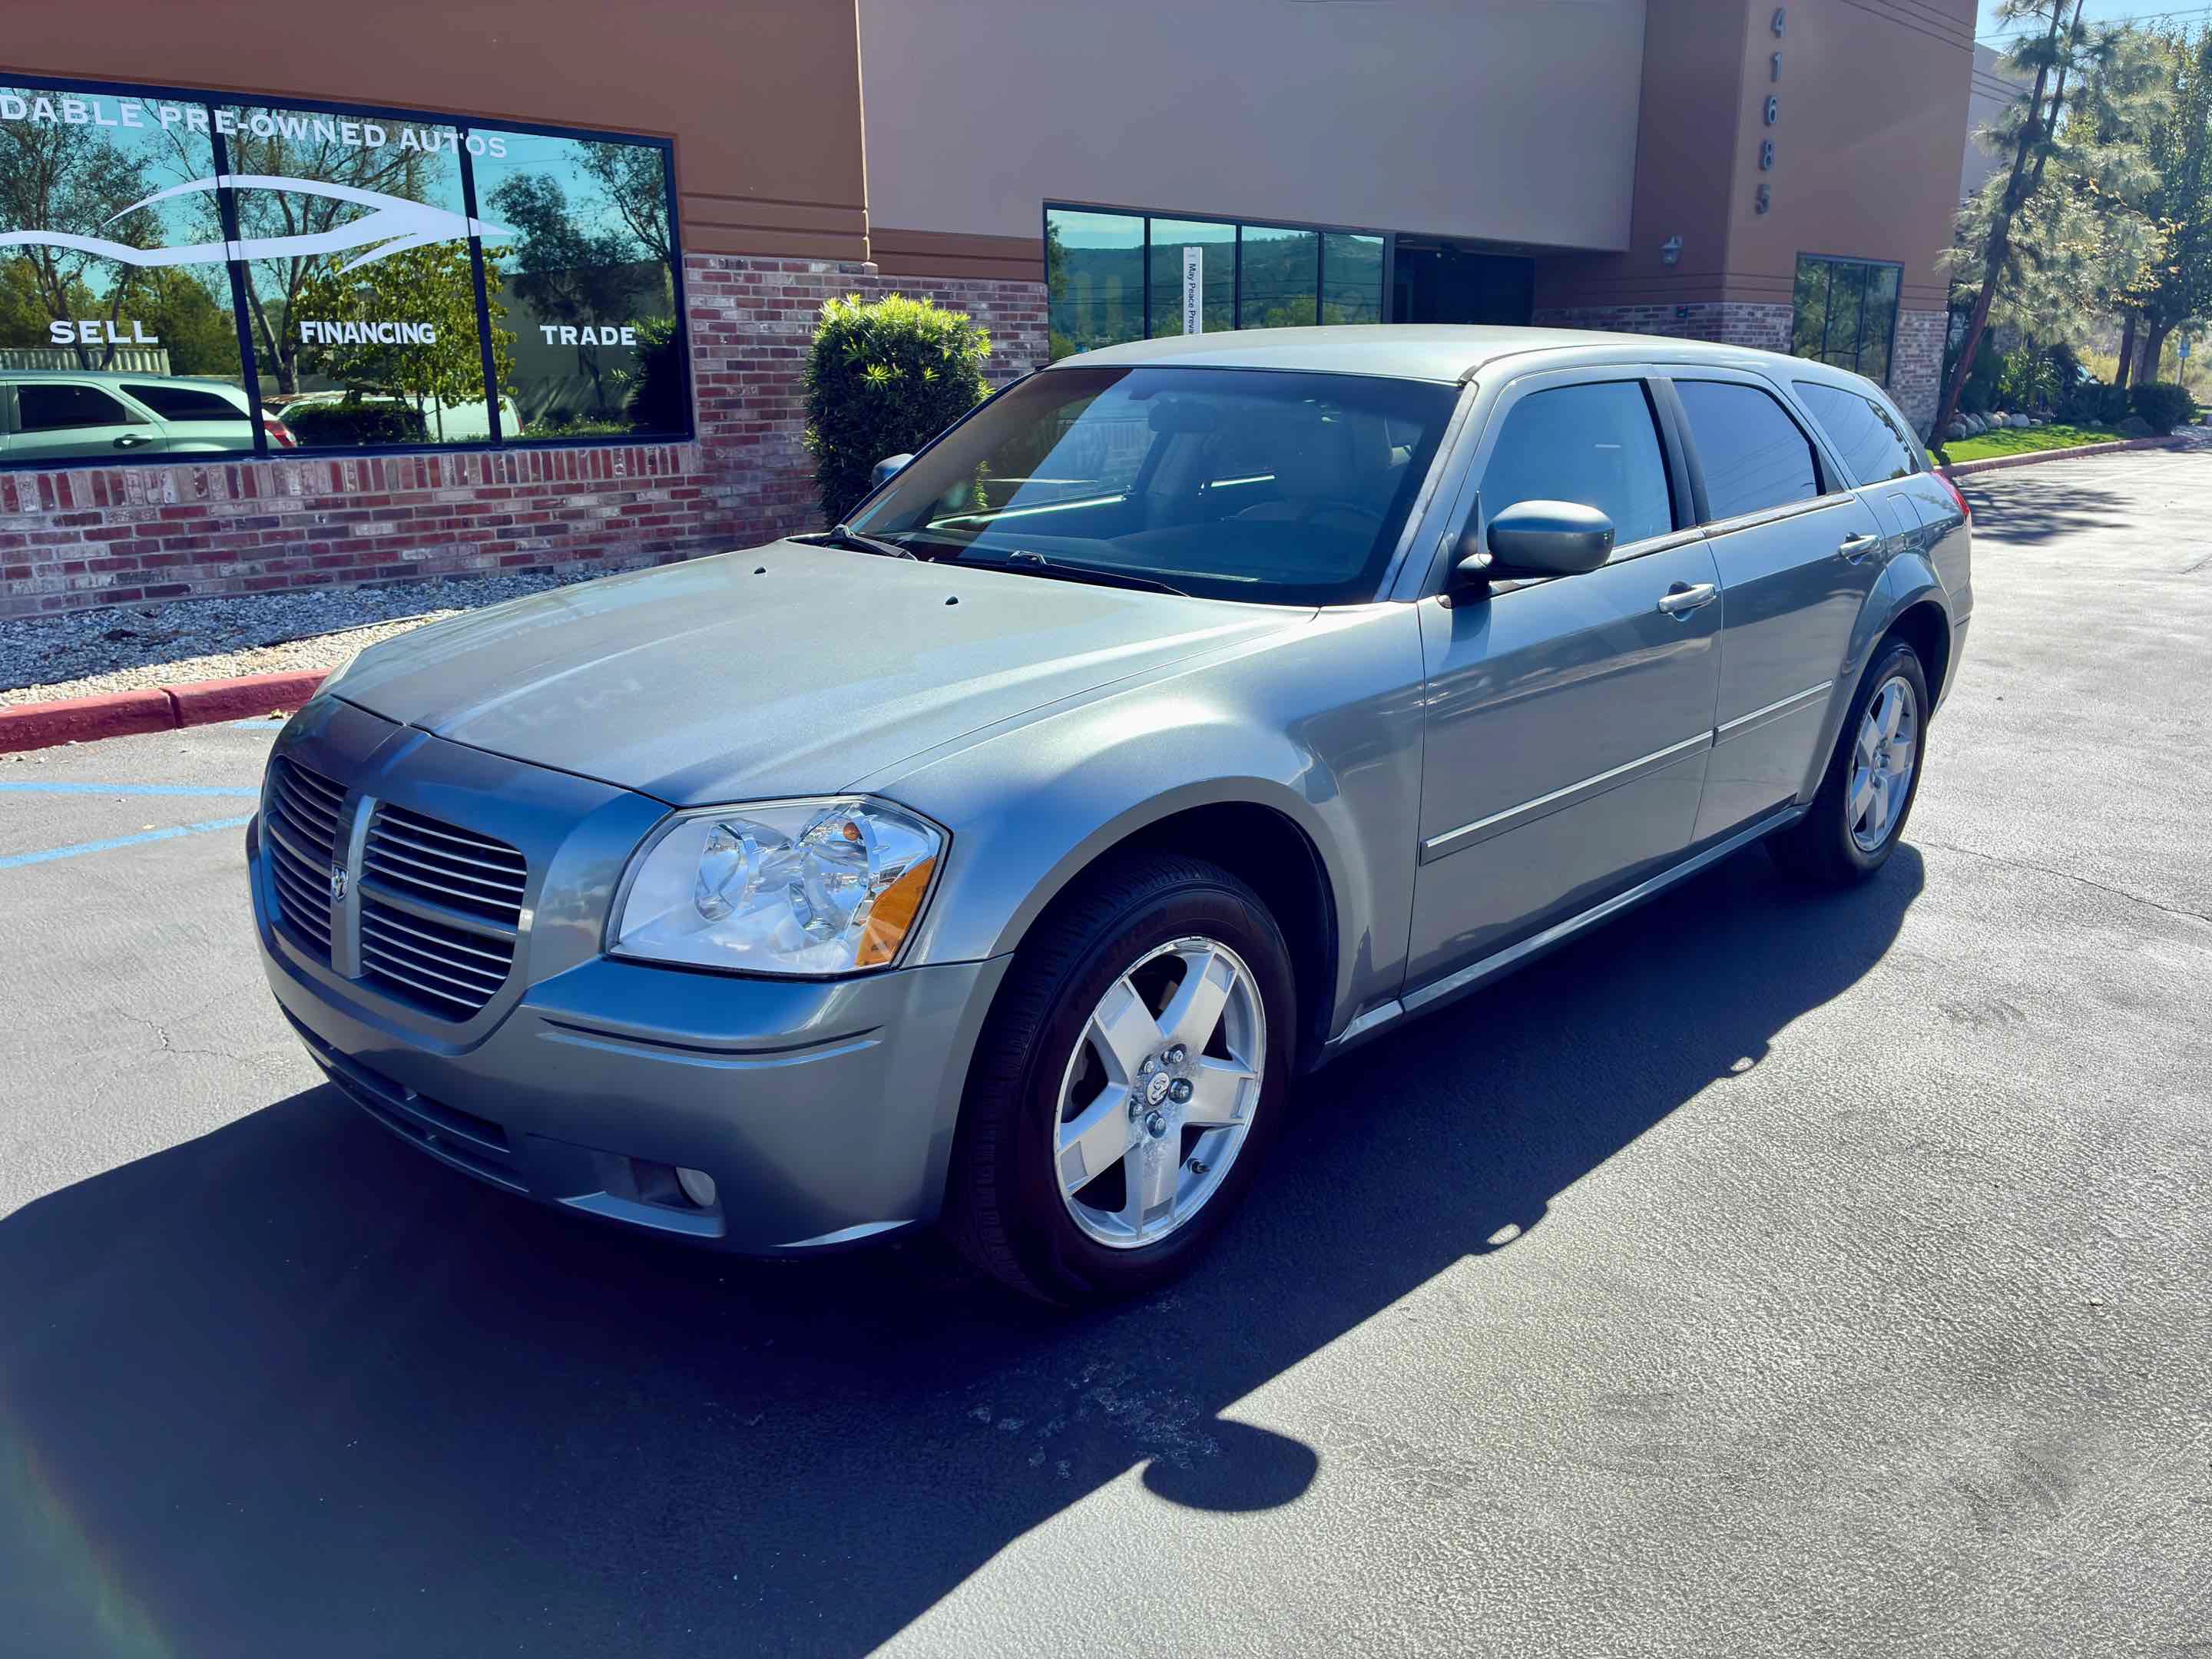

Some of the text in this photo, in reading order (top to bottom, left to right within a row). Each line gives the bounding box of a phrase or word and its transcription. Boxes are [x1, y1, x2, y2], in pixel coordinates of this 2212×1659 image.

[1756, 7, 1786, 214] 41685
[159, 106, 386, 147] PRE-OWNED
[399, 127, 507, 158] AUTOS
[1187, 263, 1196, 280] May
[49, 320, 158, 344] SELL
[300, 320, 436, 345] FINANCING
[539, 325, 637, 346] TRADE
